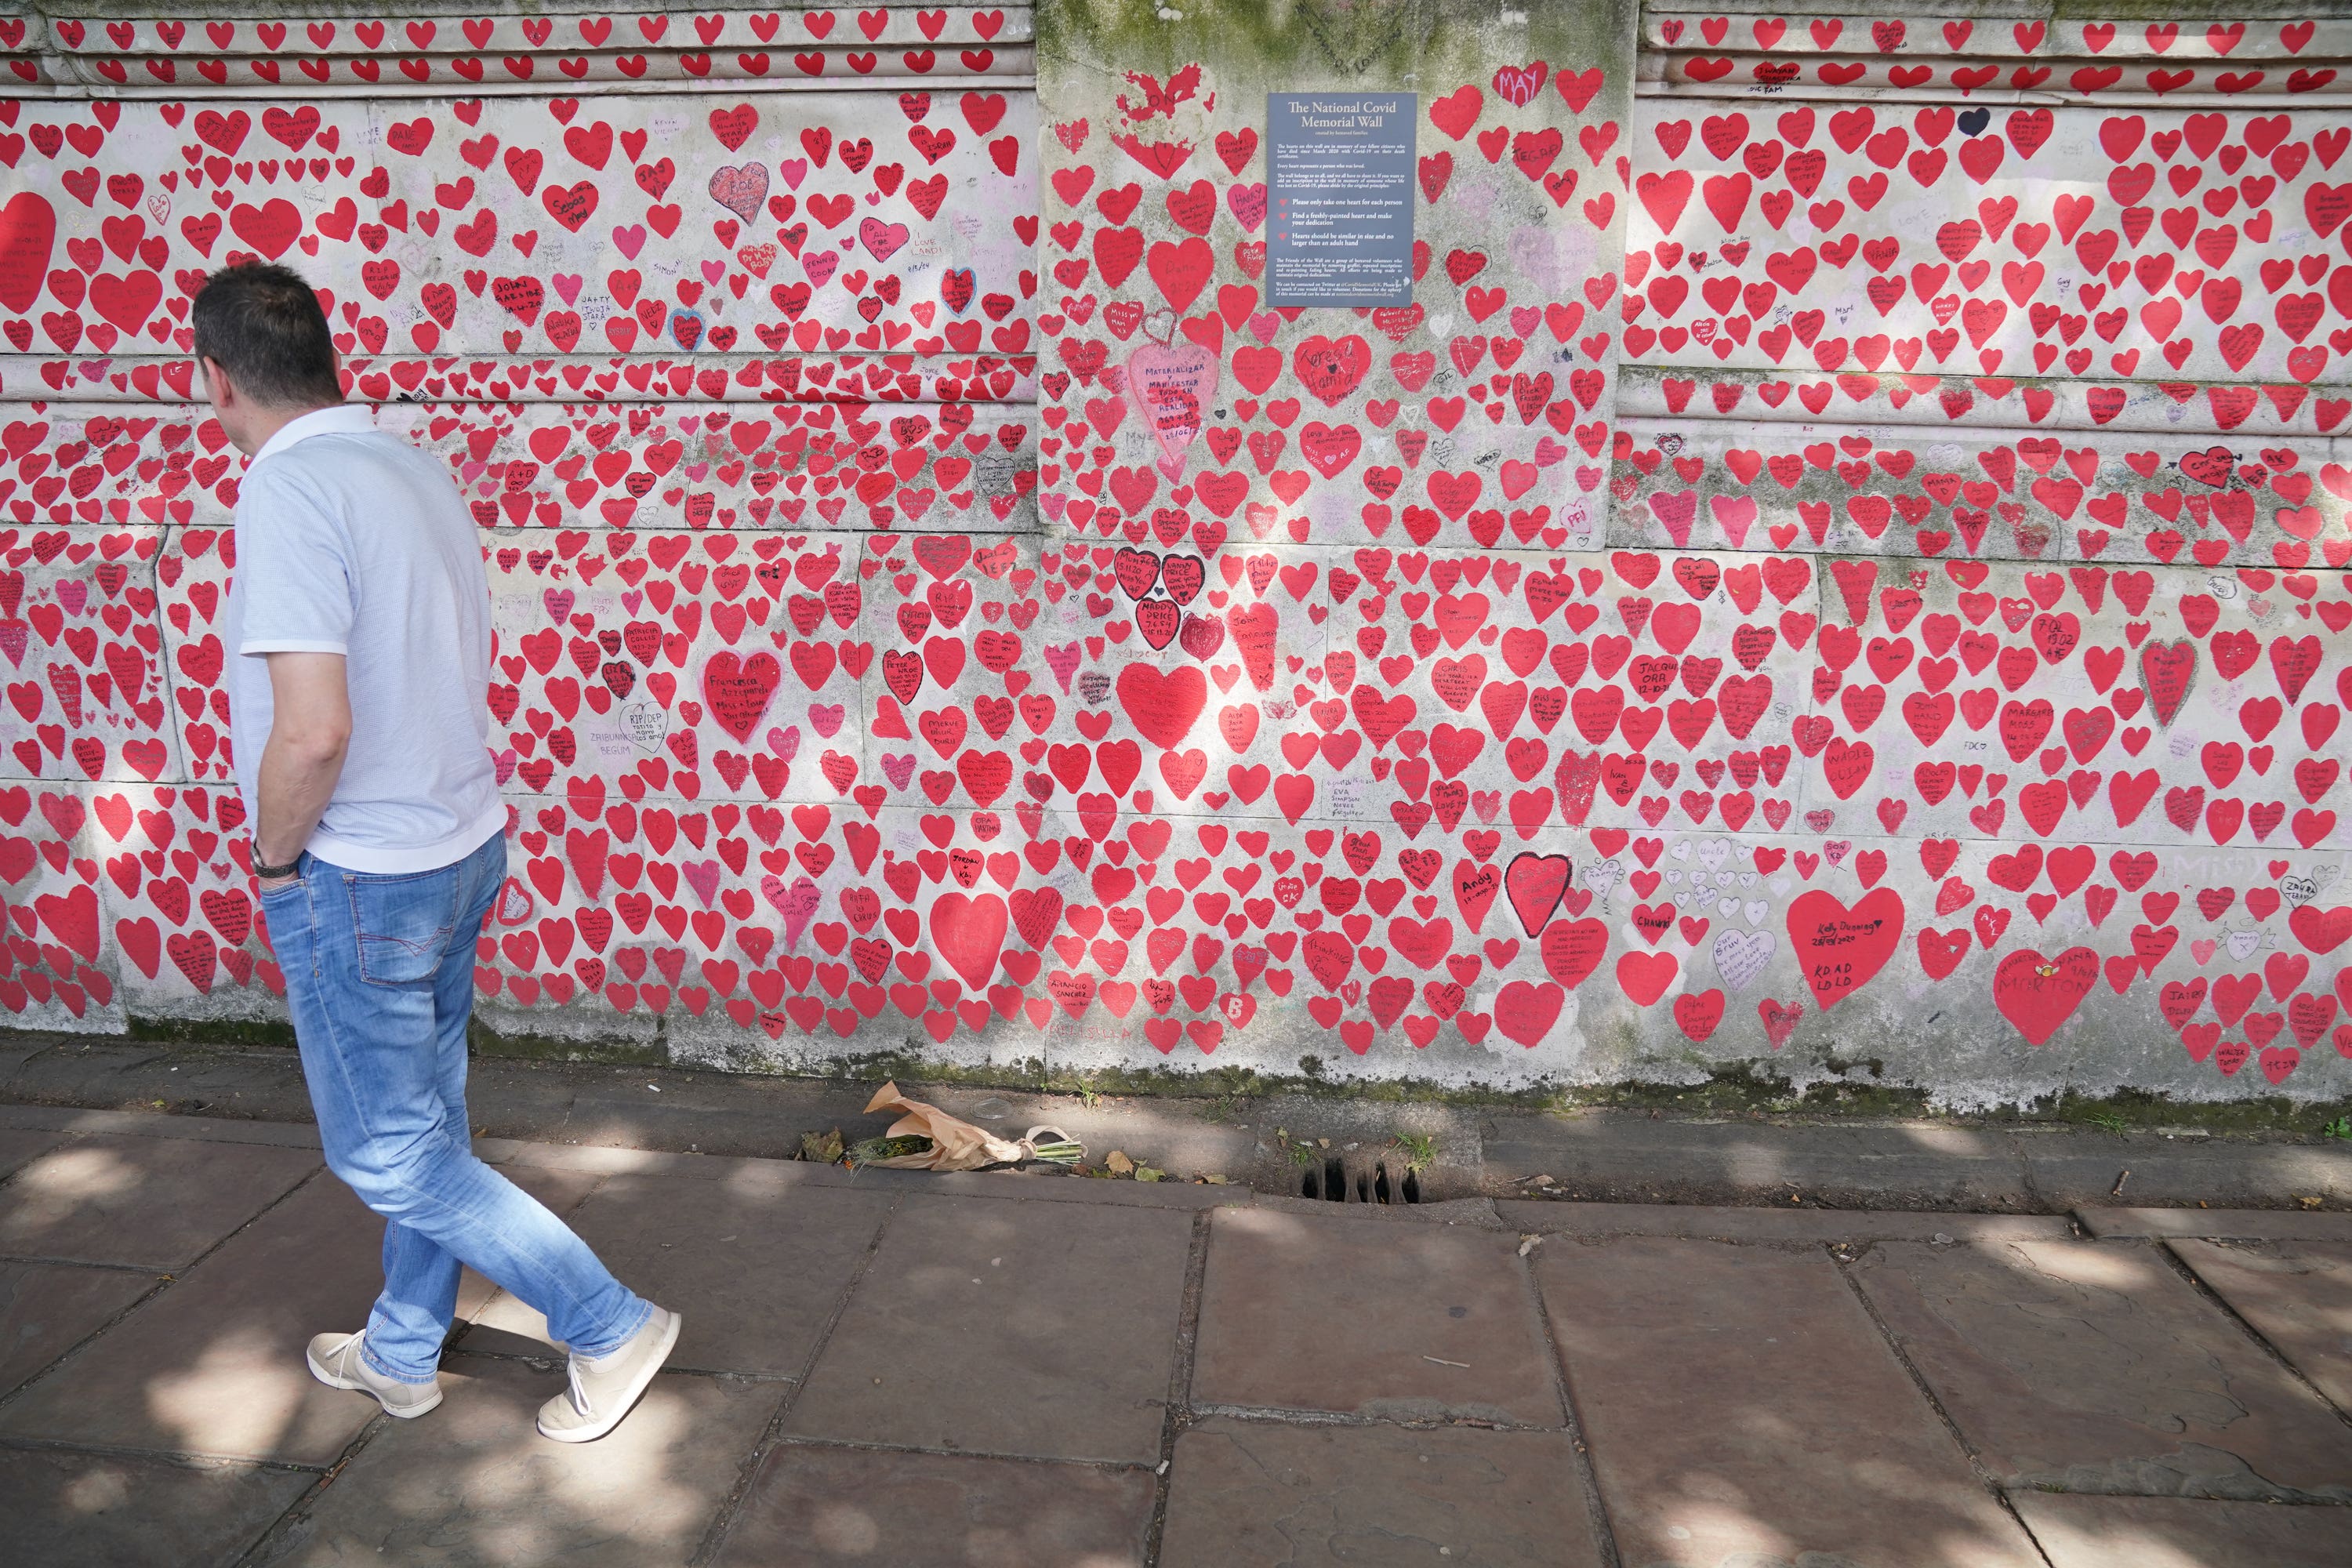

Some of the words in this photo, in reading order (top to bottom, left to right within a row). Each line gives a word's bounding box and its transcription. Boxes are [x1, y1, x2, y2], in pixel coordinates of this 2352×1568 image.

[114, 34, 129, 45] T
[166, 33, 177, 44] E
[1499, 71, 1537, 104] MAY
[1288, 102, 1309, 113] The
[1312, 102, 1359, 113] National
[1363, 102, 1396, 113] Covid
[1301, 116, 1354, 127] Memorial
[1358, 116, 1382, 127] Wall
[806, 256, 837, 270] JENNIE
[811, 267, 837, 278] COOKE
[1145, 364, 1205, 376] MATERIALIZAR
[1159, 401, 1200, 412] REALIDAD
[1166, 568, 1190, 577] PRICE
[626, 628, 659, 637] PATRICIA
[630, 713, 662, 724] RIP/DEP
[601, 746, 630, 756] BEGUM
[1462, 873, 1493, 892] Andy
[1817, 923, 1837, 937] Kelly
[1840, 921, 1874, 935] Dunning
[2058, 952, 2092, 967] NANA
[1999, 977, 2090, 993] MORTON
[1228, 998, 1243, 1018] B
